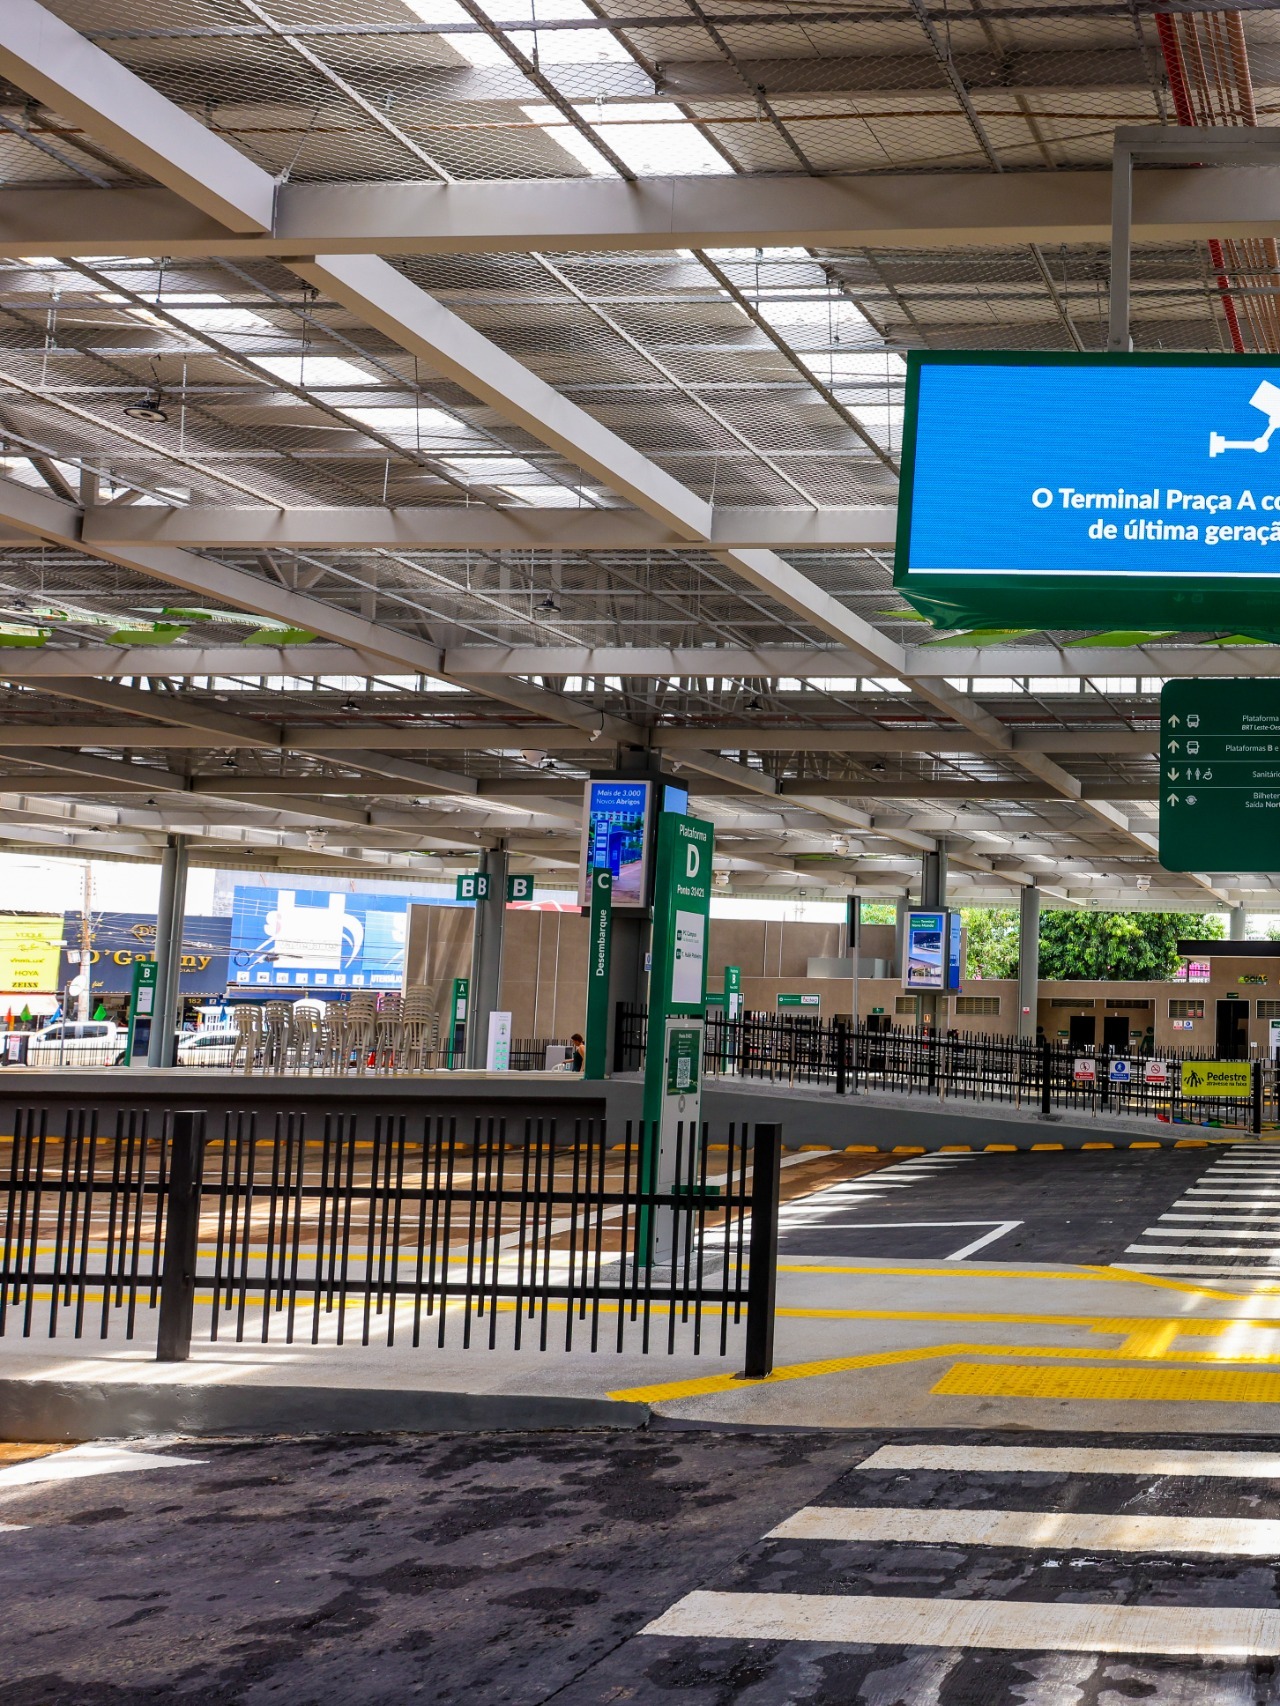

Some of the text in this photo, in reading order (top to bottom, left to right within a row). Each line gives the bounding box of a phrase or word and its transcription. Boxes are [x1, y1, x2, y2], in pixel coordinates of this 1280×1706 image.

[1031, 487, 1053, 508] O
[1058, 488, 1159, 509] Terminal
[1167, 489, 1232, 514] Praça
[1237, 490, 1256, 510] A
[1089, 519, 1117, 540] de
[1123, 519, 1198, 541] última
[1225, 744, 1266, 752] Plataformas
[622, 789, 641, 797] 3.000
[680, 823, 707, 842] Plataforma
[686, 843, 700, 878] D
[461, 879, 474, 897] B
[477, 877, 487, 896] B
[512, 878, 527, 897] B
[597, 872, 610, 889] C
[677, 884, 691, 896] Ponto
[596, 909, 607, 976] Desembarque
[143, 968, 151, 978] B
[459, 984, 466, 993] A
[1206, 1071, 1247, 1082] Pedestre
